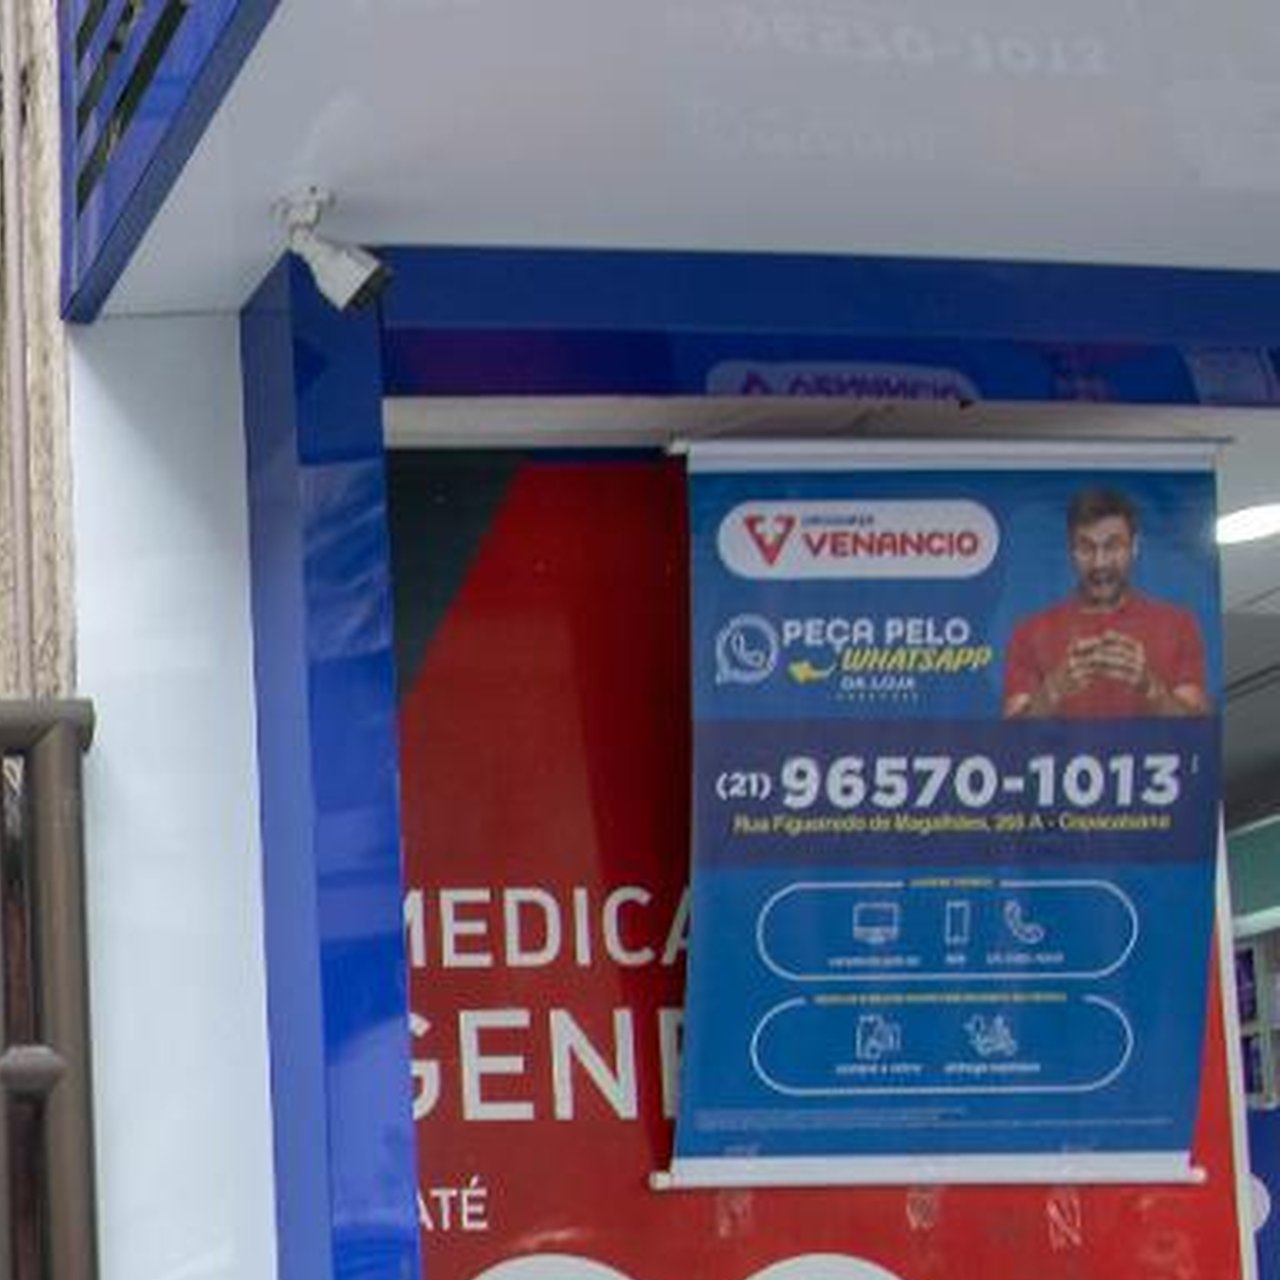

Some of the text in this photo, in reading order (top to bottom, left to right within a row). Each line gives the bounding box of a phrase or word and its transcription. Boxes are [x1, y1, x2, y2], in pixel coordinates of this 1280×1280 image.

[803, 531, 979, 557] VENANCIO
[783, 618, 970, 651] PEÇA PELO
[842, 646, 992, 672] WHATSAPP
[716, 772, 772, 801] (21)
[781, 755, 1181, 808] 96570-1013
[734, 815, 770, 833] Rua
